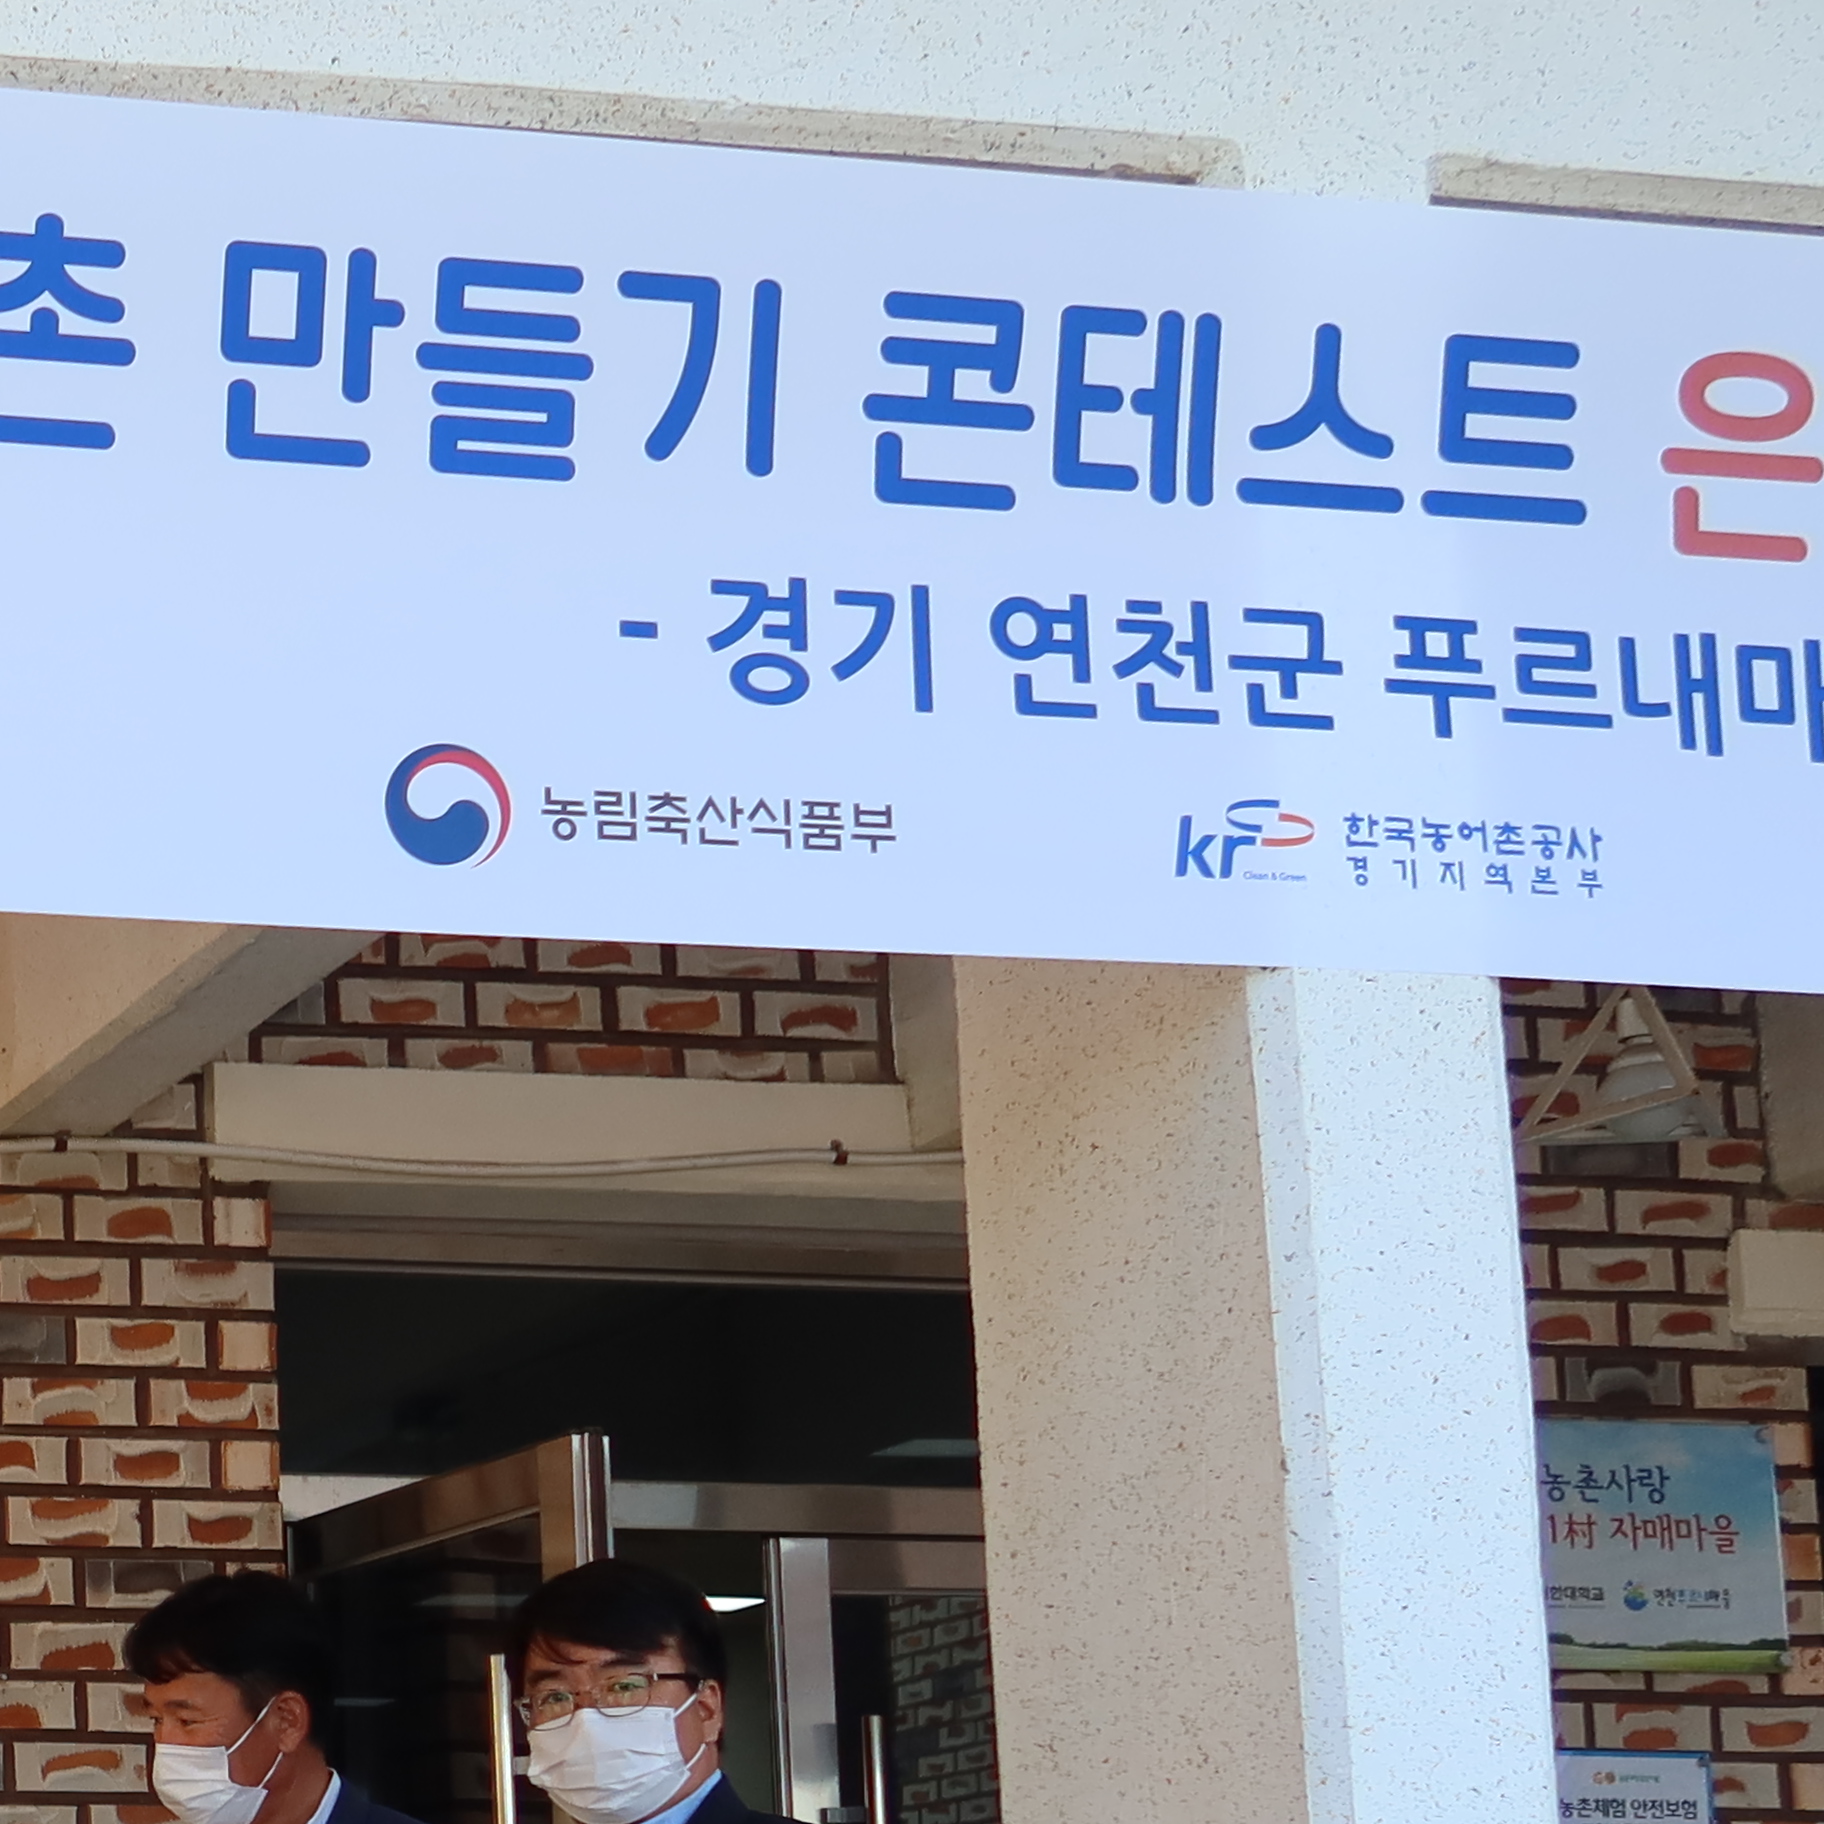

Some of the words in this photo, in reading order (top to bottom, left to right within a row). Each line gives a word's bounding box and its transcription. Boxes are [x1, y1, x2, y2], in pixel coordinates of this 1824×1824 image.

[220, 240, 782, 482] 만들기
[862, 291, 1587, 526] 콘테스트
[1661, 351, 1824, 562] 은
[707, 577, 934, 713] 경기
[990, 594, 1343, 731] 연천군
[1385, 615, 1824, 763] 푸르내마
[541, 787, 896, 853] 농림축산식품부
[1343, 812, 1603, 863] 한국농어촌공사
[1540, 1463, 1670, 1504] 농촌사랑
[1609, 1512, 1740, 1554] 자매마을
[1545, 1585, 1604, 1601] 한대학교
[1560, 1797, 1626, 1819] 농촌체험
[1630, 1798, 1698, 1820] 안전보험
